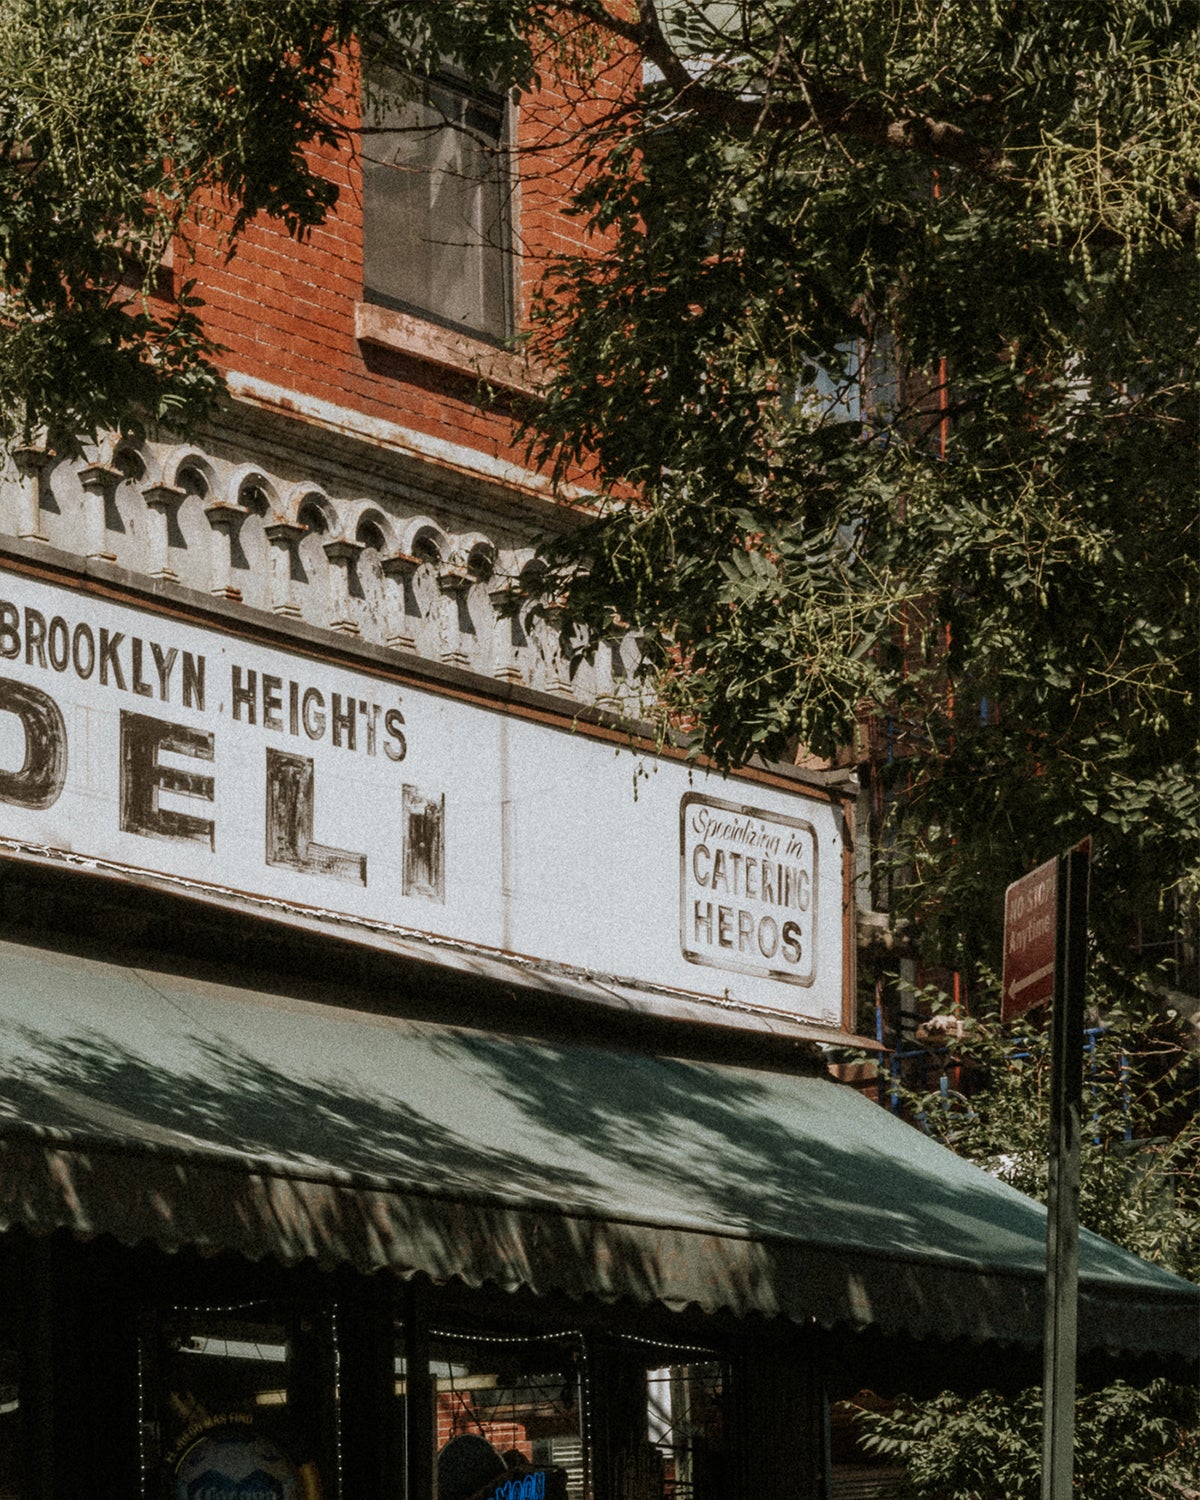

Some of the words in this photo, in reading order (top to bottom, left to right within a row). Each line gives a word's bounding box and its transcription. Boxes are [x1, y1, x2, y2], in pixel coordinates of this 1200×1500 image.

[231, 664, 408, 763] HEIGHTS
[692, 808, 782, 854] Specializing
[786, 832, 804, 859] in
[692, 843, 810, 912] CATERING
[693, 899, 803, 964] HEROS
[1008, 914, 1051, 955] Anytime
[1009, 894, 1024, 925] NO
